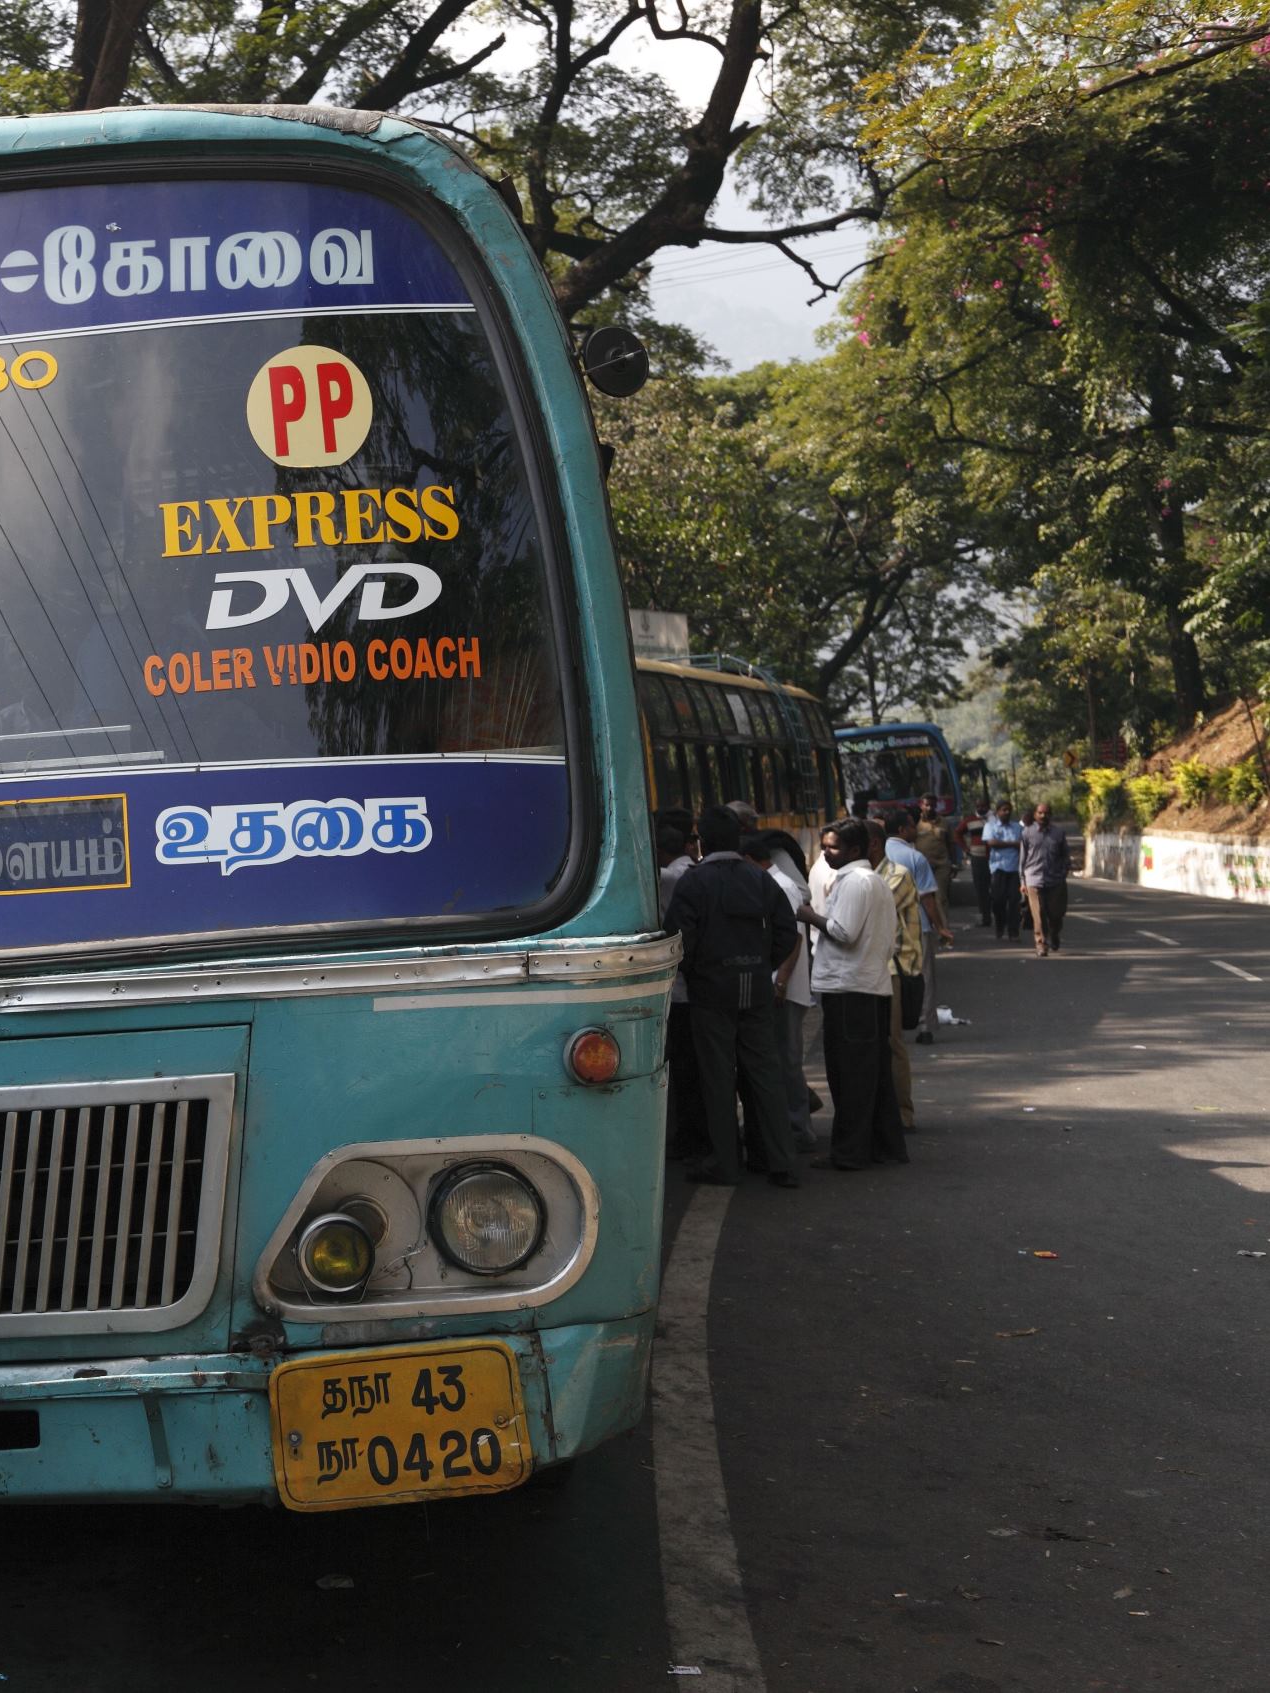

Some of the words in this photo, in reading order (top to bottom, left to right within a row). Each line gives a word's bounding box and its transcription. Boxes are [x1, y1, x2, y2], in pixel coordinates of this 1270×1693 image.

[158, 486, 460, 558] EXPRESS
[205, 562, 443, 634] DVD
[144, 648, 256, 696] COLER
[262, 641, 356, 686] VIDIO
[366, 636, 481, 680] COACH
[155, 797, 433, 876] உதகை
[411, 1365, 466, 1415] 43
